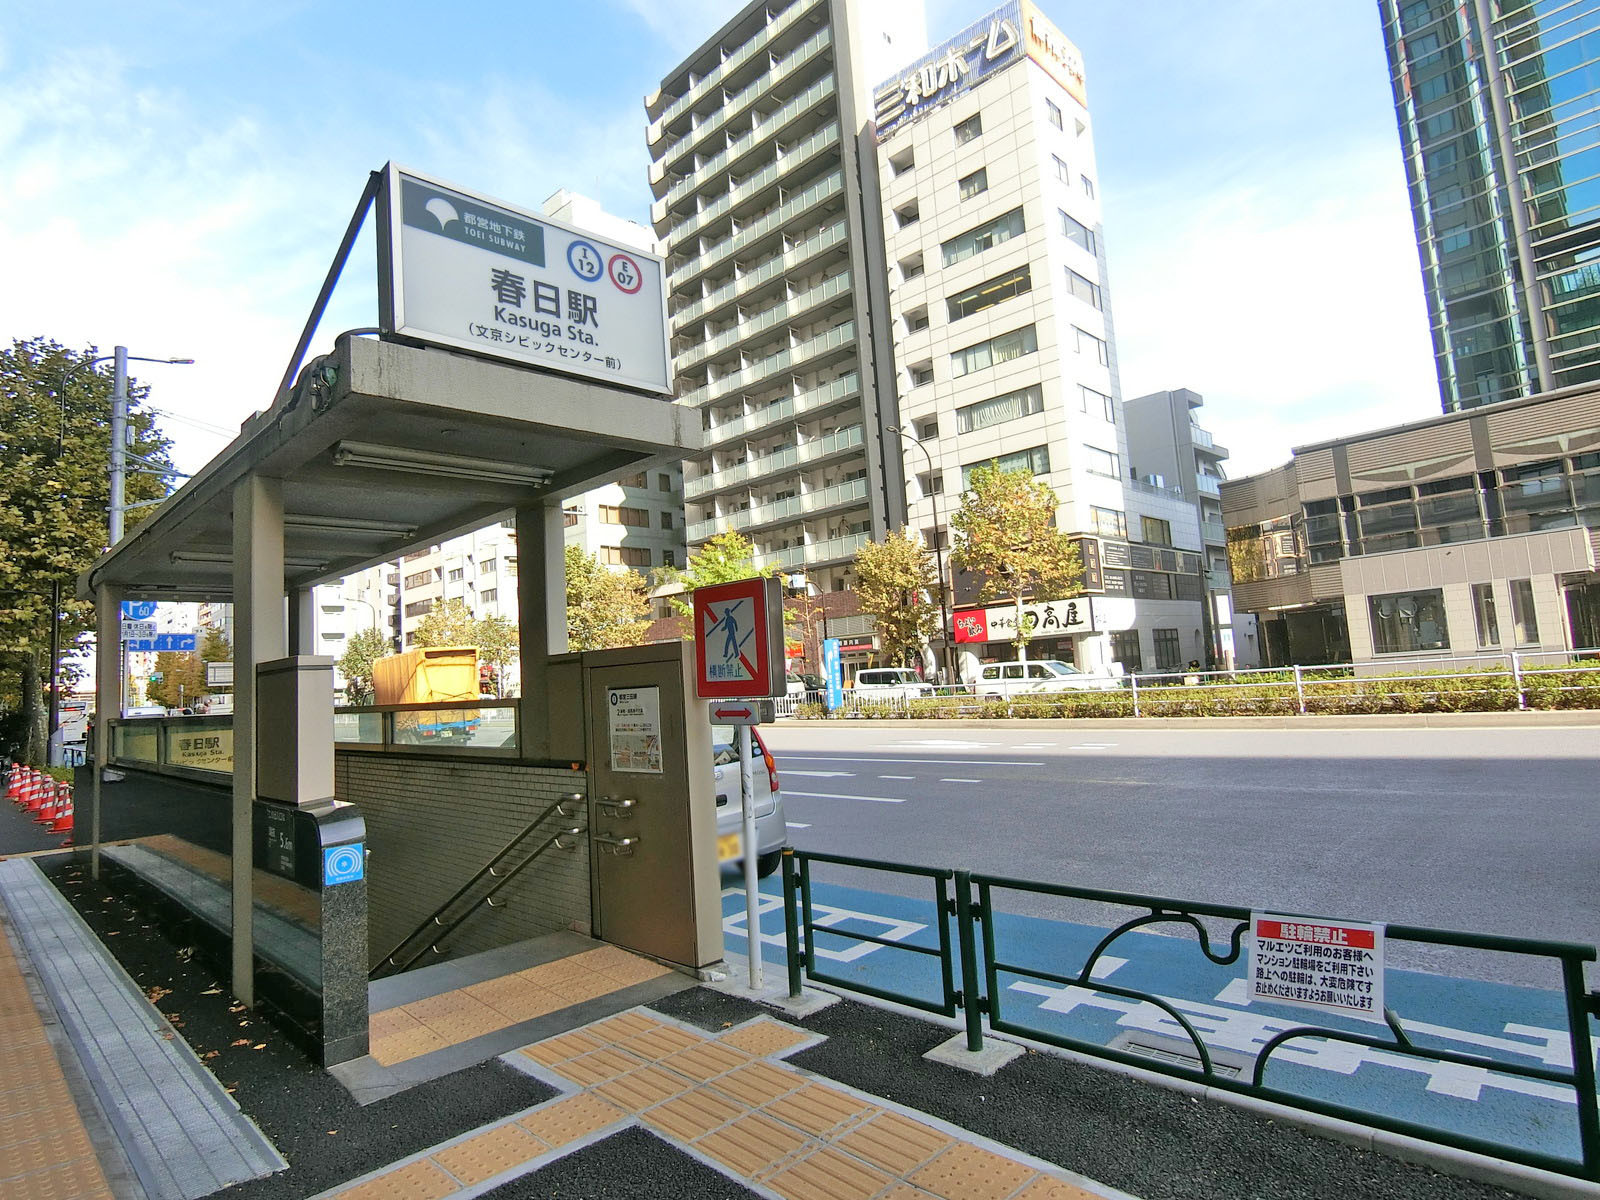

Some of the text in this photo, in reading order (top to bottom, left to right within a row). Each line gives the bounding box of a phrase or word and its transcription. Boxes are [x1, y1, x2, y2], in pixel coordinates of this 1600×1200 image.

[875, 18, 1019, 128] 三和ホーム
[463, 211, 526, 242] 都営地下鉄
[464, 227, 526, 253] TOEI SUBWAY
[581, 248, 589, 259] I
[577, 258, 595, 275] 12
[617, 271, 634, 286] 07
[621, 261, 628, 272] E
[490, 267, 599, 329] 春日駅
[494, 306, 599, 347] Kasuga Sta.
[709, 663, 743, 679] 横断禁止
[178, 736, 220, 750] 春日駅
[1280, 923, 1348, 945] 駐輪禁止
[1257, 939, 1374, 962] マルエツご利用のお客様へ
[1256, 953, 1374, 978] マンション駐輪場をご利用下さい
[1256, 967, 1374, 994] 路上への駐輪は、大変危険です
[1255, 981, 1374, 1010] お止めくださいますようお願いいたします
